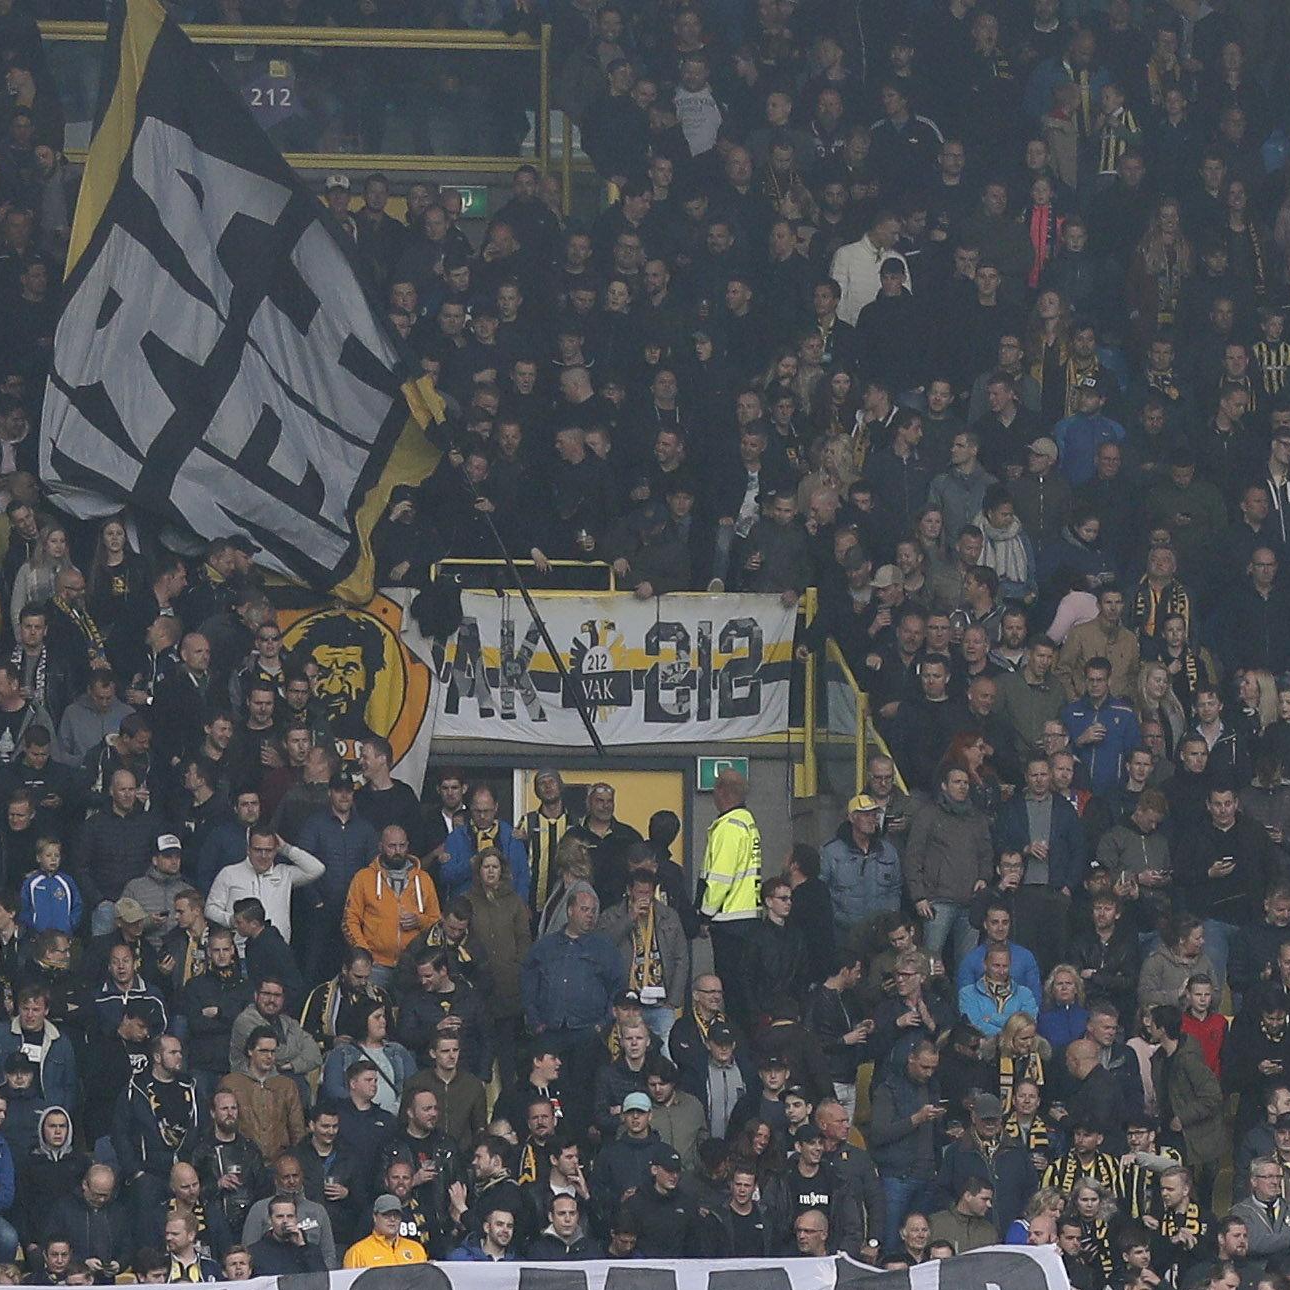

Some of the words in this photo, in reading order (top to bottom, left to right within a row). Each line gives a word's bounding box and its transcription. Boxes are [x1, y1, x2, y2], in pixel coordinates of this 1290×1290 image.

[250, 88, 292, 106] 212
[587, 653, 607, 671] 212
[643, 616, 763, 723] 212
[581, 680, 614, 700] VAK
